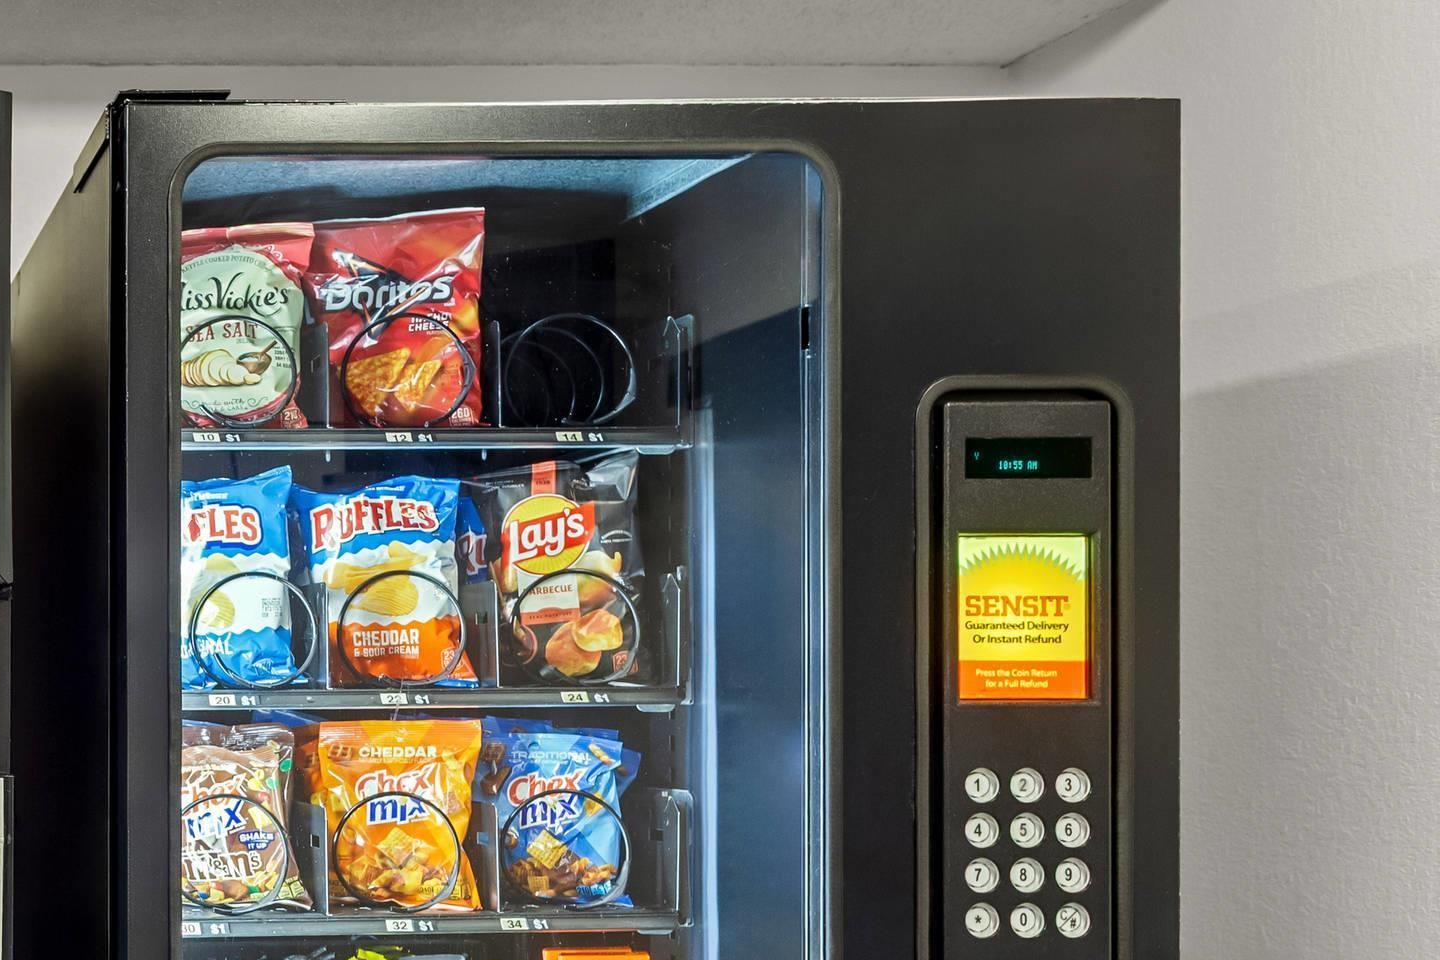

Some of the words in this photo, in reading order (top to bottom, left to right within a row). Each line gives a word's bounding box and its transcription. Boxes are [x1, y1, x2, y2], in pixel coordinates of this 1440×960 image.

[326, 277, 454, 311] Doritos
[393, 434, 407, 442] 12
[511, 507, 585, 562] Lay's
[965, 595, 1069, 617] SENSIT
[965, 621, 1025, 631] Guaranteed
[1027, 621, 1069, 632] Delivery
[353, 629, 419, 647] CHEDDAR
[973, 634, 985, 644] Or
[987, 634, 1022, 644] Instant
[1025, 634, 1062, 644] Refund
[363, 647, 386, 657] SOUR
[388, 645, 419, 655] CREAM
[976, 668, 996, 677] Press
[997, 669, 1011, 677] the
[1012, 669, 1029, 677] Coin
[1031, 669, 1057, 677] Return
[985, 680, 995, 688] for
[1004, 680, 1017, 688] Full
[1019, 680, 1048, 688] Refund
[215, 696, 230, 704] 20
[568, 693, 583, 702] 24
[359, 746, 437, 758] CHEDDAR
[512, 751, 591, 762] TRADITIONAL
[508, 770, 585, 807] Chex
[1019, 779, 1027, 791] 2
[1065, 778, 1072, 791] 3
[974, 823, 982, 836] 4
[1019, 823, 1027, 836] 5
[1065, 823, 1072, 836] 6
[974, 868, 982, 882] 7
[1019, 868, 1027, 881] 8
[1065, 868, 1072, 881] 9
[393, 921, 408, 930] 32
[508, 920, 522, 929] 34
[1020, 913, 1027, 926] 0
